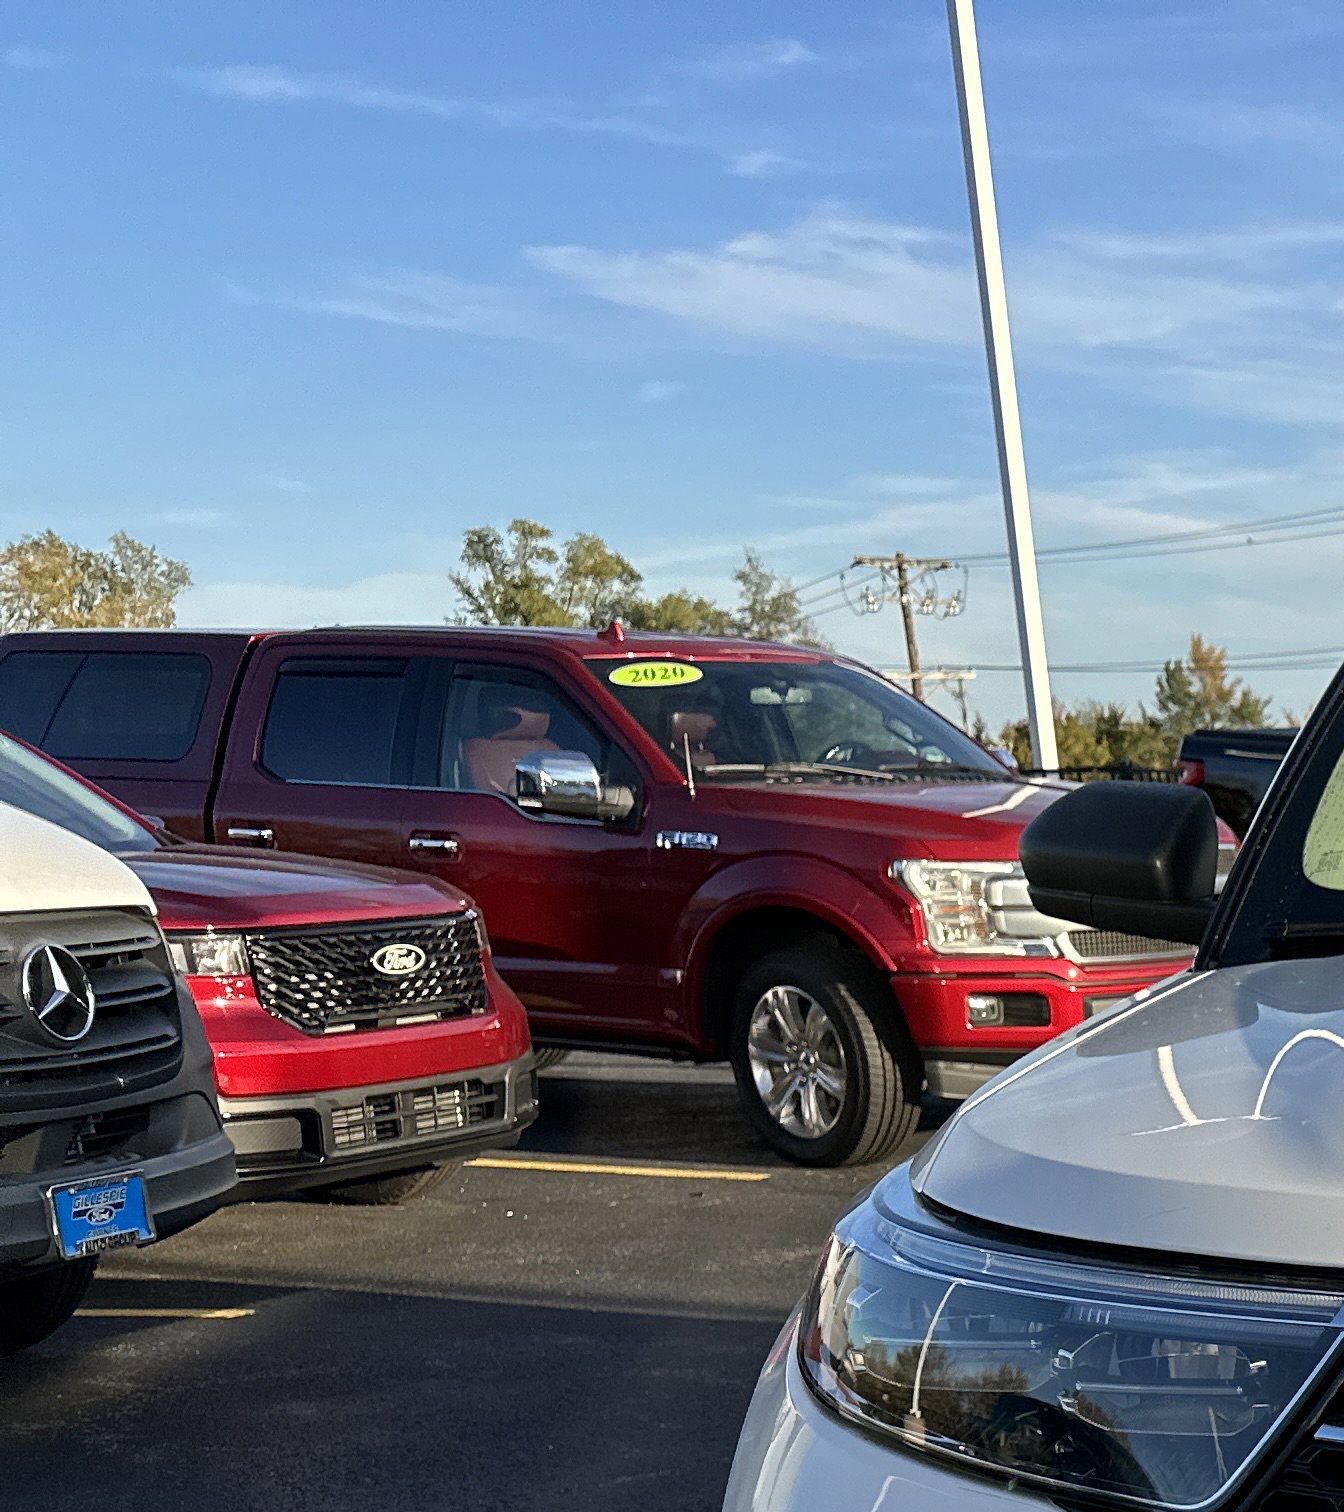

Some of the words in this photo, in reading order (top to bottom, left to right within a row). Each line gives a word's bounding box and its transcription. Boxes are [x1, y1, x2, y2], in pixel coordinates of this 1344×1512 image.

[628, 666, 685, 683] 2020
[383, 949, 416, 970] Ford
[72, 1186, 128, 1209] GILLESPIE
